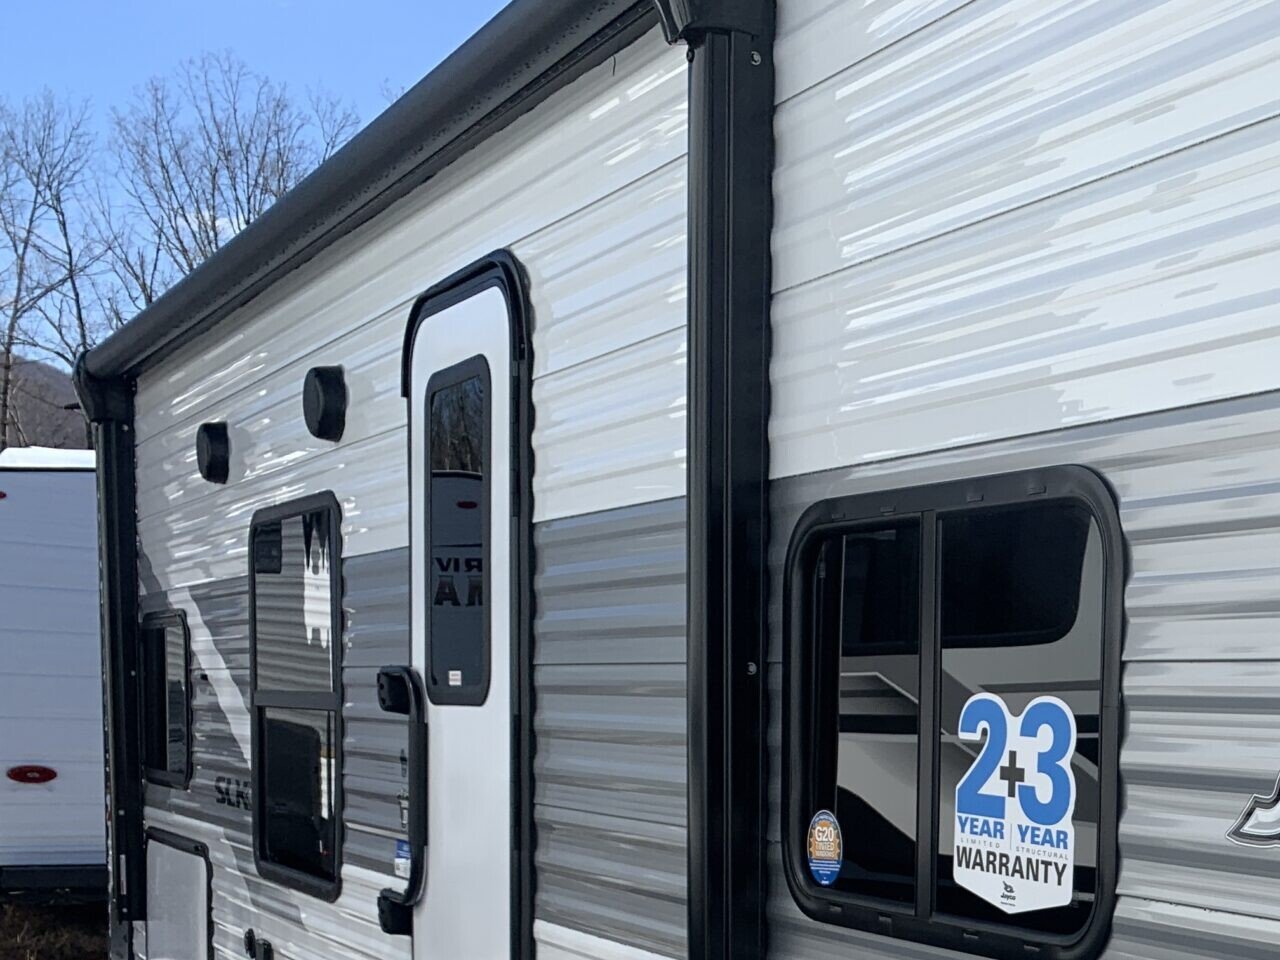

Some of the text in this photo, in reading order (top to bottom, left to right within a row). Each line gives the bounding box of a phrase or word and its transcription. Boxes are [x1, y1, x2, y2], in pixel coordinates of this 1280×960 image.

[815, 826, 834, 842] G20
[957, 815, 1069, 850] YEAR YEAR
[960, 837, 1069, 860] LIMITED STRUCTURAL
[956, 845, 1068, 887] WARRANTY
